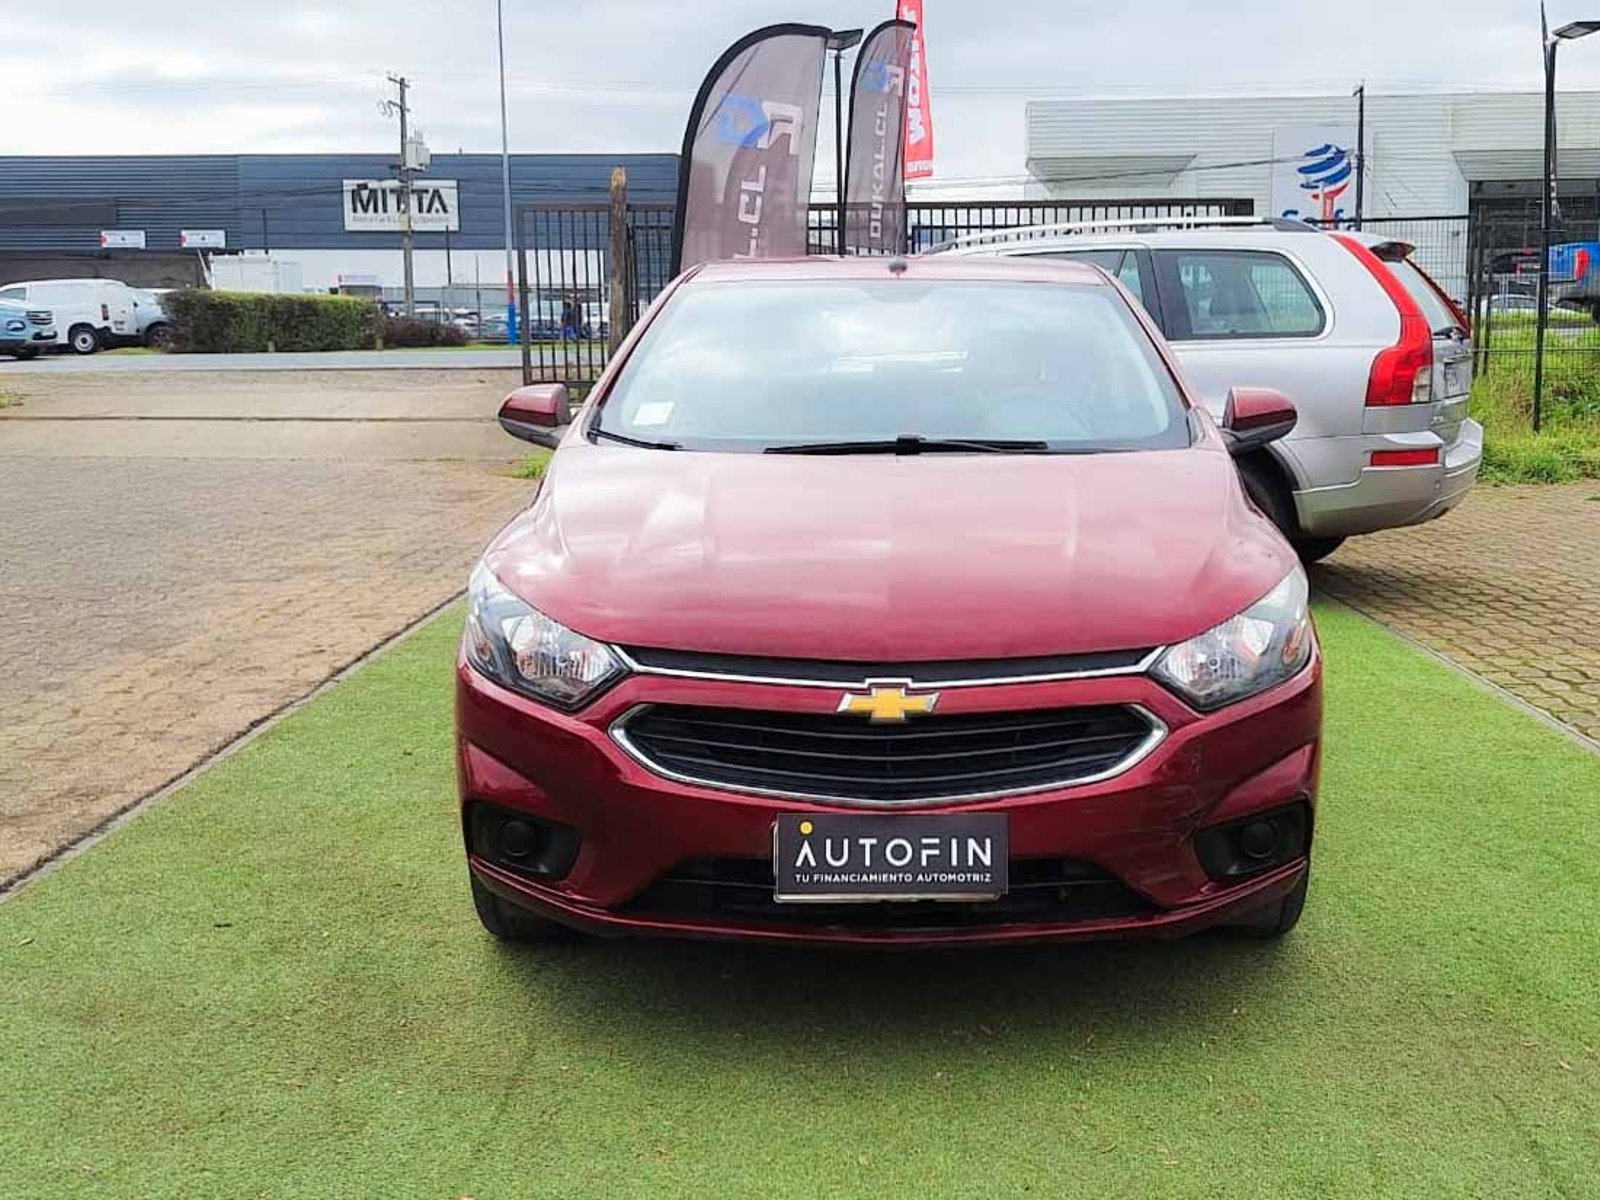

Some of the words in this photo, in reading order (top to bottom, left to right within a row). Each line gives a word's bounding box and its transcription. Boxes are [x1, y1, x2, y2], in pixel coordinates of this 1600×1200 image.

[350, 184, 449, 214] MITTA
[795, 821, 992, 867] AUTOFIN
[795, 873, 809, 883] TU
[813, 873, 913, 883] FINANCIAMIENTO
[916, 873, 992, 883] AUTOMOTRIZ
